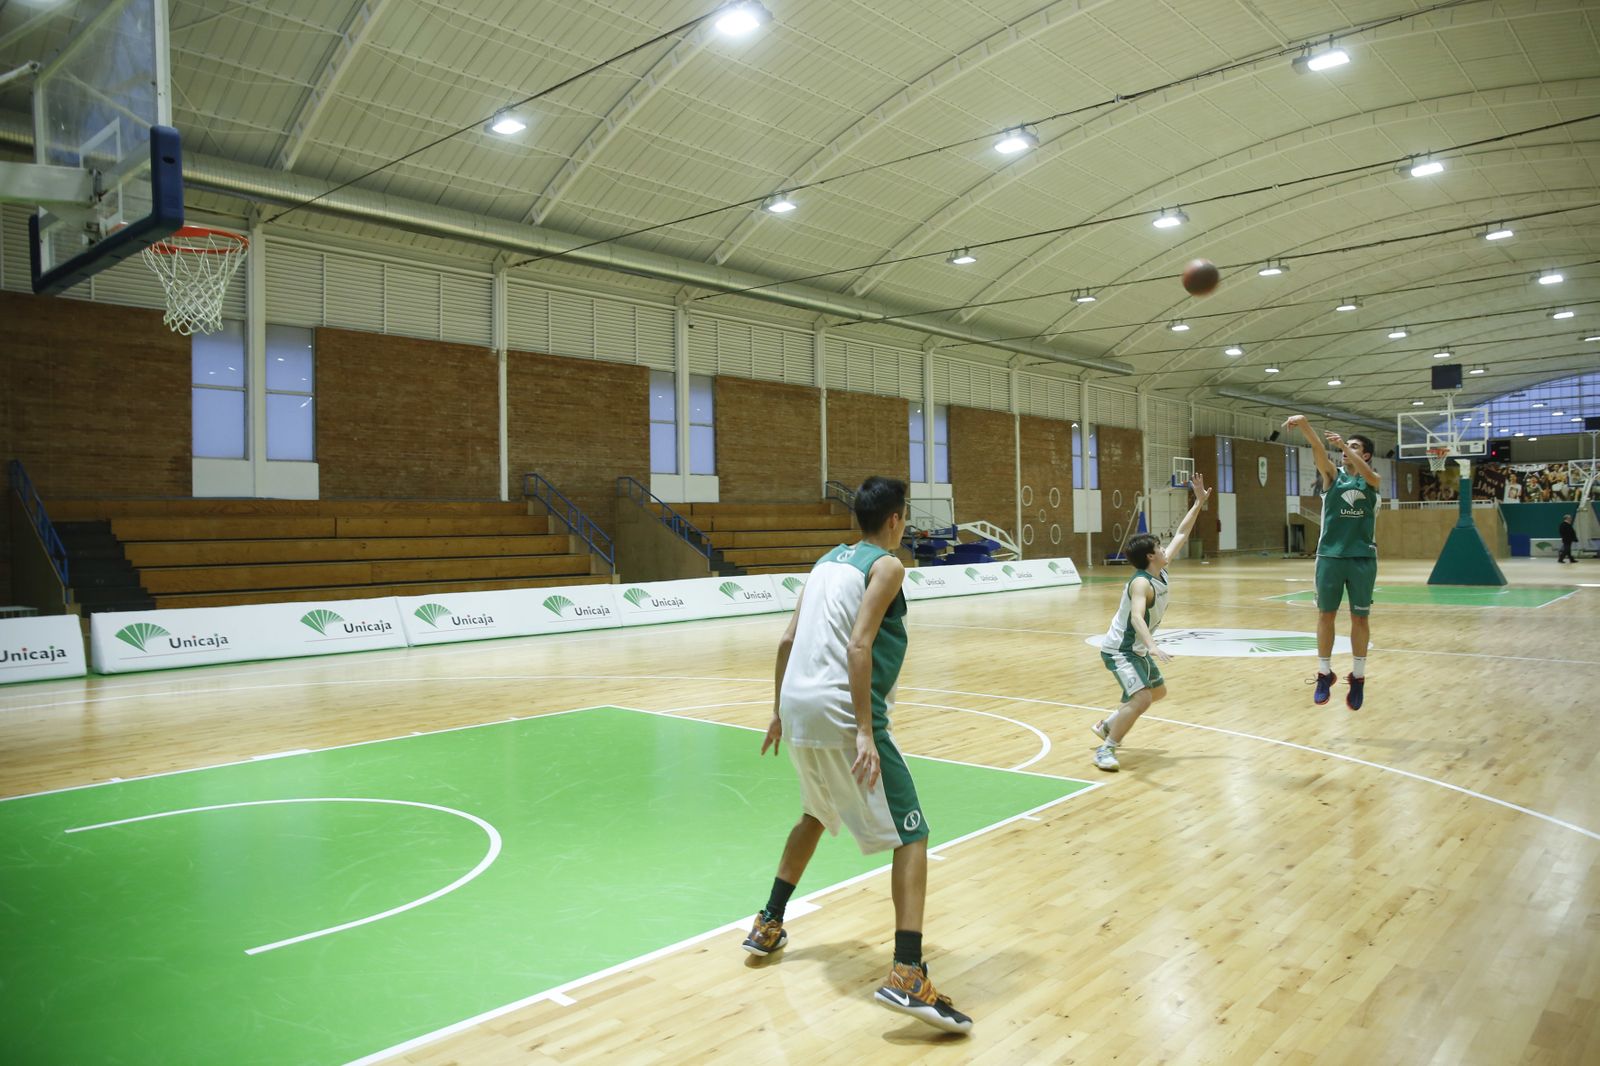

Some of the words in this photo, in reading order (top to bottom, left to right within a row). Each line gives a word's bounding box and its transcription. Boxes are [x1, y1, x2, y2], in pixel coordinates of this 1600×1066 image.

[925, 578, 946, 587] Unicaja
[743, 589, 772, 601] Unicaja
[651, 596, 685, 608] Unicaja
[574, 604, 611, 617] Unicaja
[451, 613, 495, 626] Unicaja
[343, 619, 393, 634] Unicaja
[168, 632, 229, 650] Unicaja
